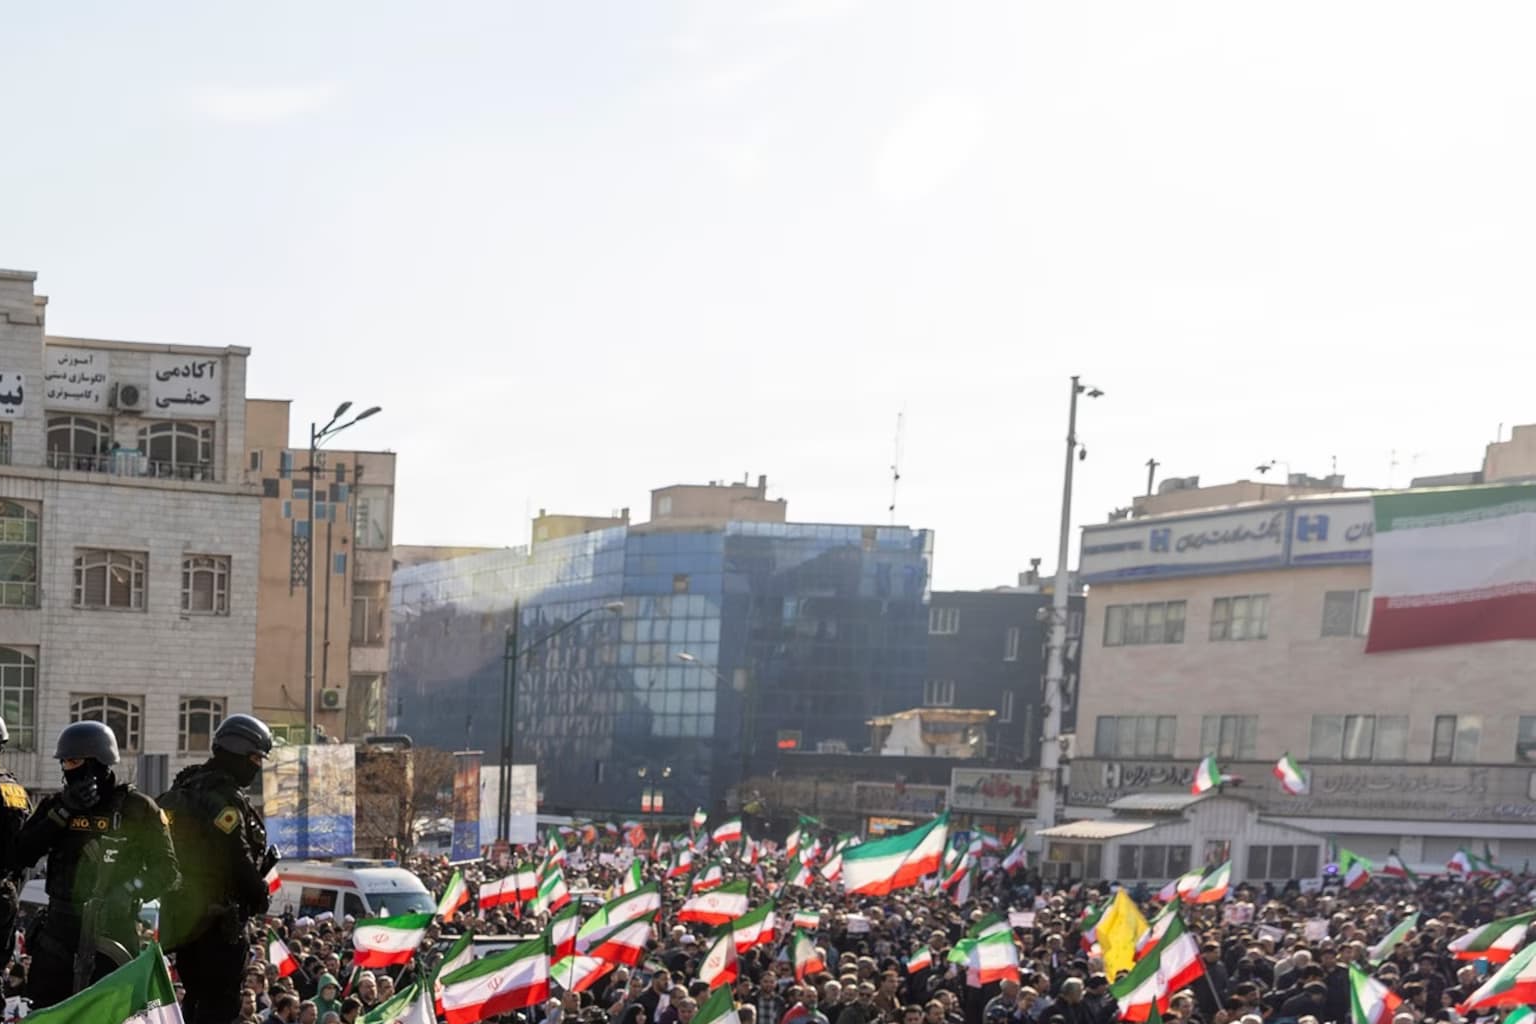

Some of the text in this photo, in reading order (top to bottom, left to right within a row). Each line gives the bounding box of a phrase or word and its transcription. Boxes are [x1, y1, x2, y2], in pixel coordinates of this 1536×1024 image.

[57, 354, 93, 366] آموزش
[45, 371, 67, 382] دستی
[156, 360, 217, 382] آکادمی
[156, 388, 211, 408] حنفی
[72, 818, 107, 830] NOO
